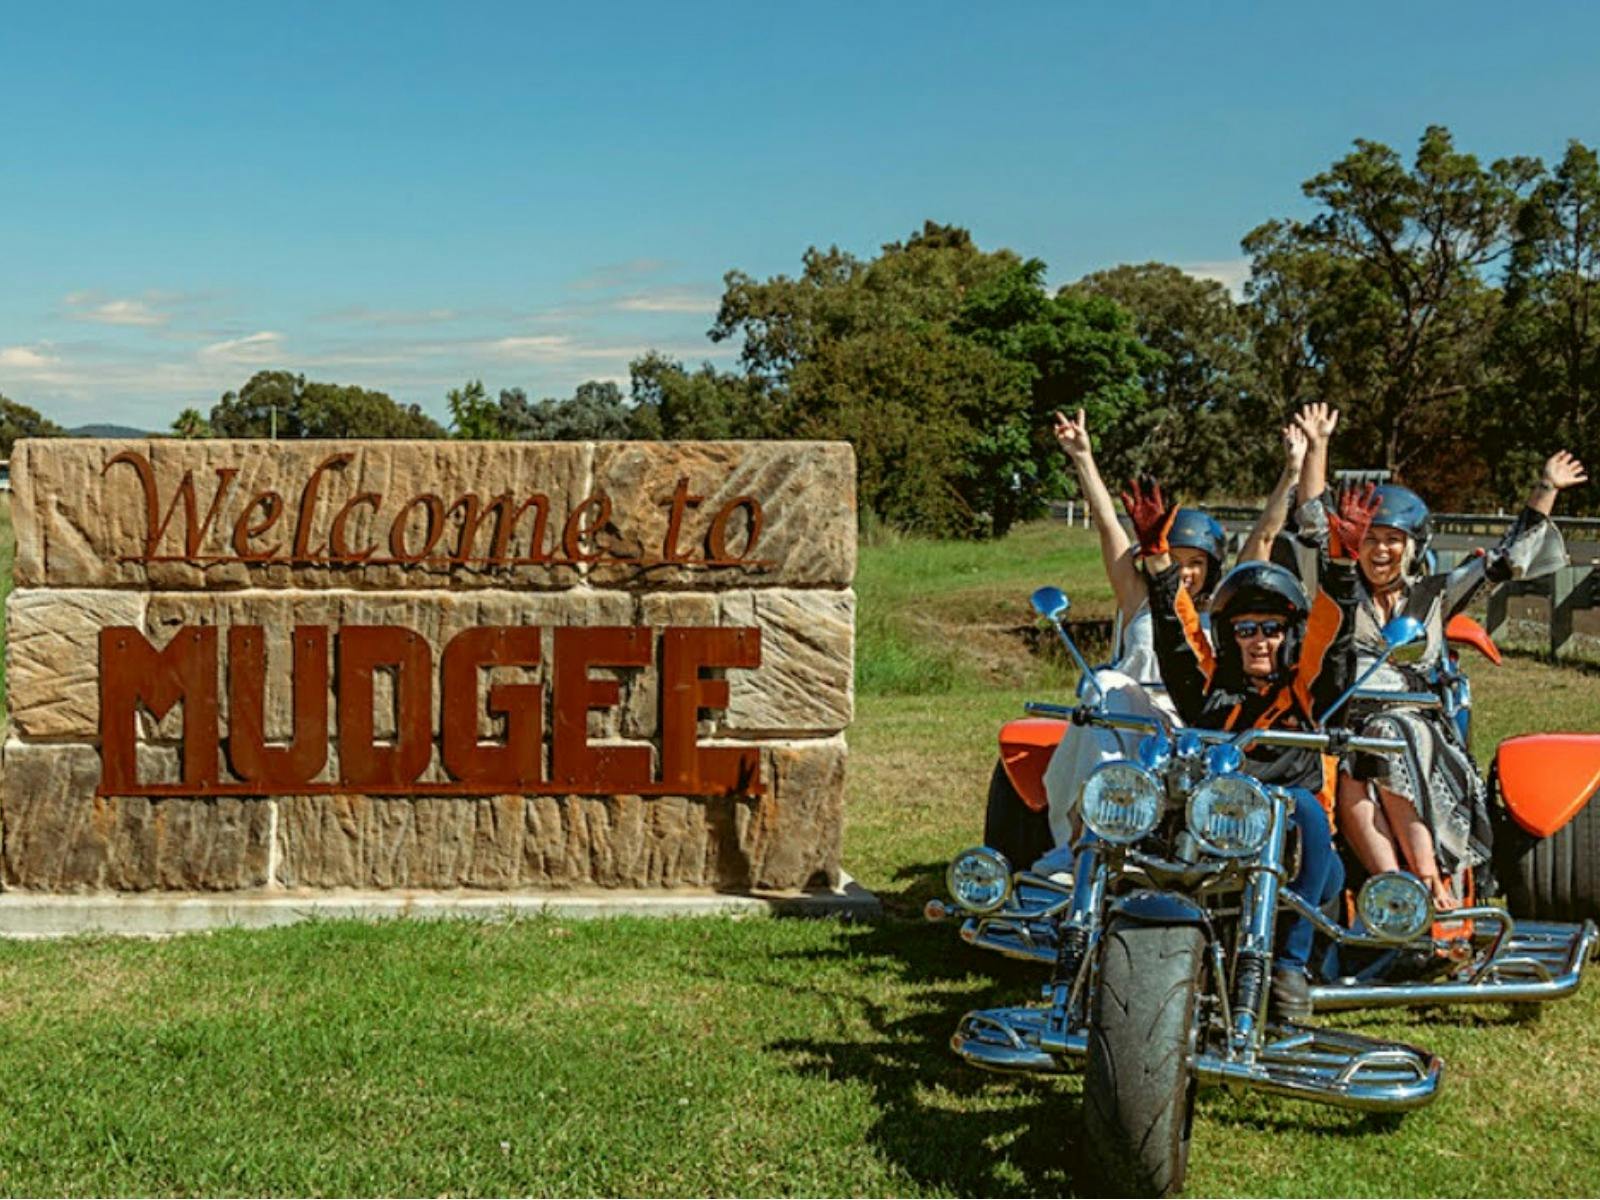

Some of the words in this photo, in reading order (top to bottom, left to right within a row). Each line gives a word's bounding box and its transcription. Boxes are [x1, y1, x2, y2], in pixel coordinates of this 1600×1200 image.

[101, 451, 611, 561] Welcome
[658, 476, 763, 560] to
[99, 625, 762, 795] MUDGEE
